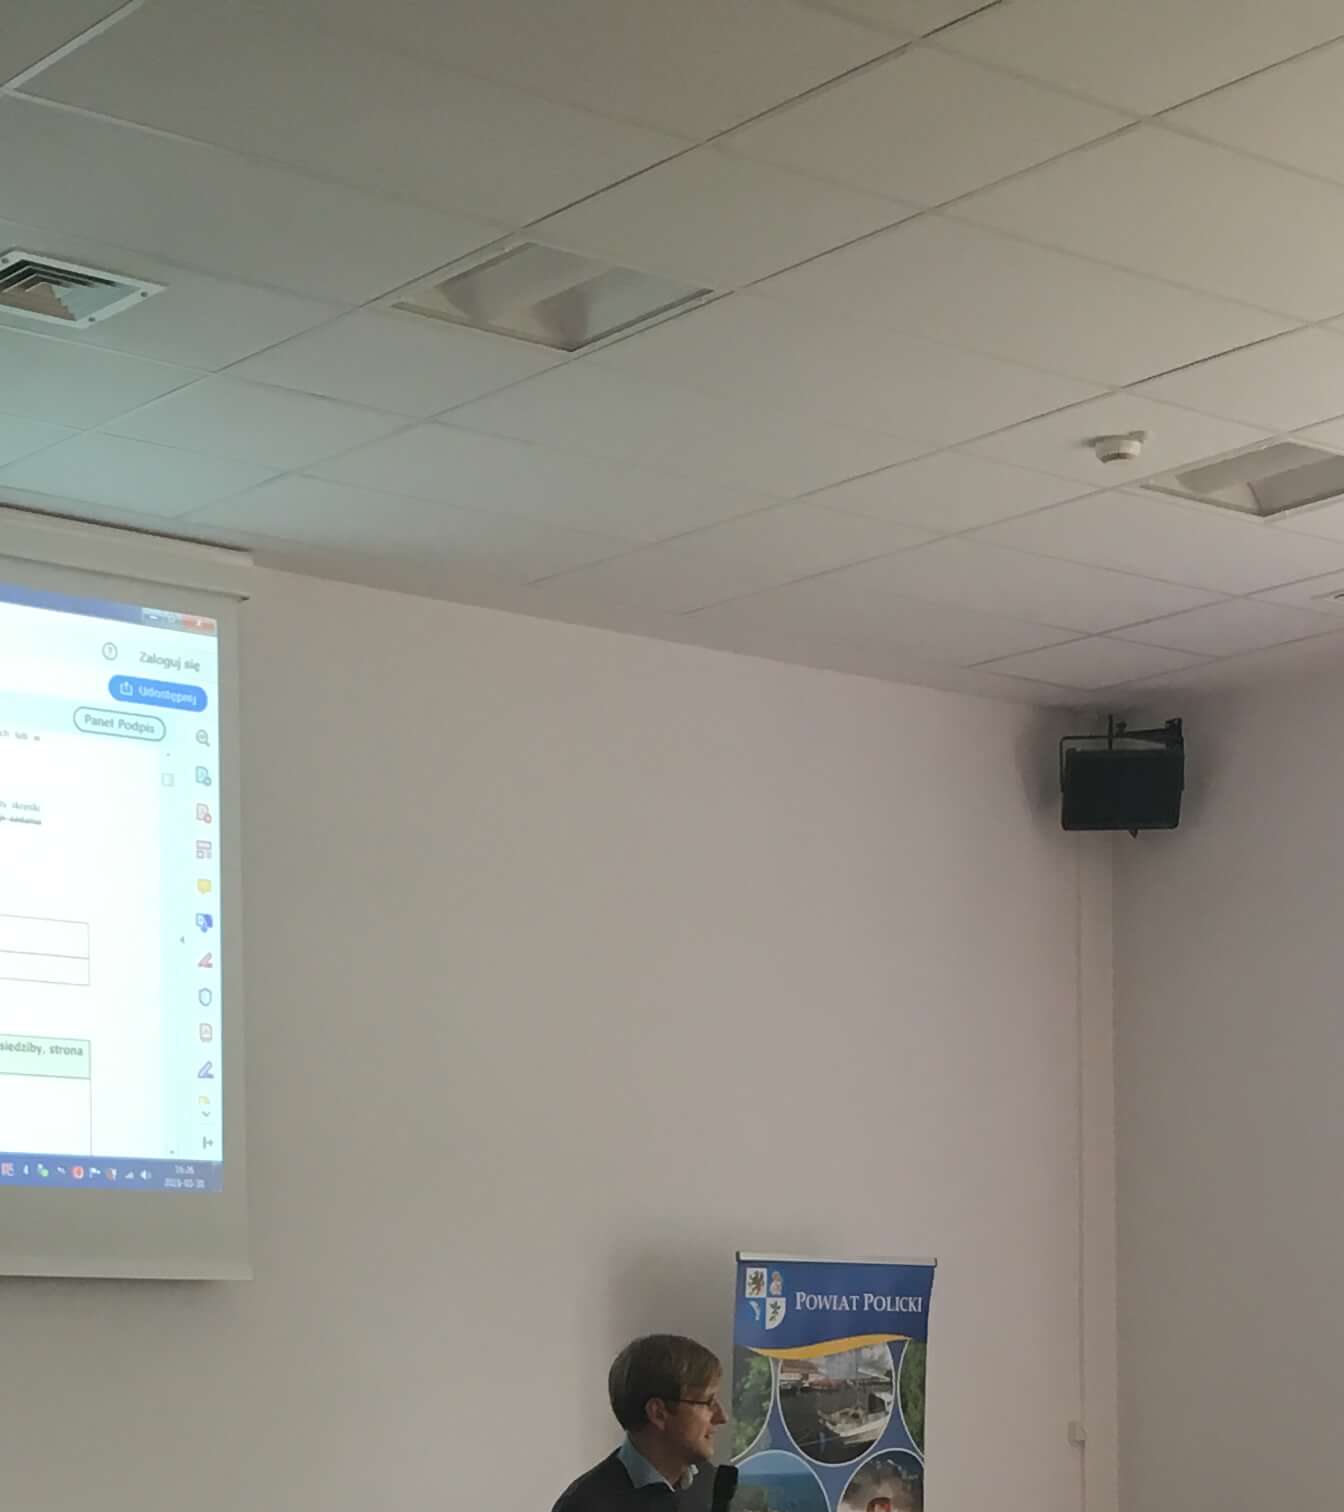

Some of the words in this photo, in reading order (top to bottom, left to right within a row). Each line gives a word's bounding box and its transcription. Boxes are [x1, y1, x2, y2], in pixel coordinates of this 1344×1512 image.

[138, 650, 182, 671] Zaloguj
[183, 658, 201, 673] się
[83, 713, 114, 729] Panel
[117, 718, 155, 734] Podpis
[0, 1041, 46, 1056] siedziby,
[48, 1044, 84, 1057] strona
[795, 1291, 860, 1311] POWIAT
[863, 1293, 922, 1312] POLICKI
